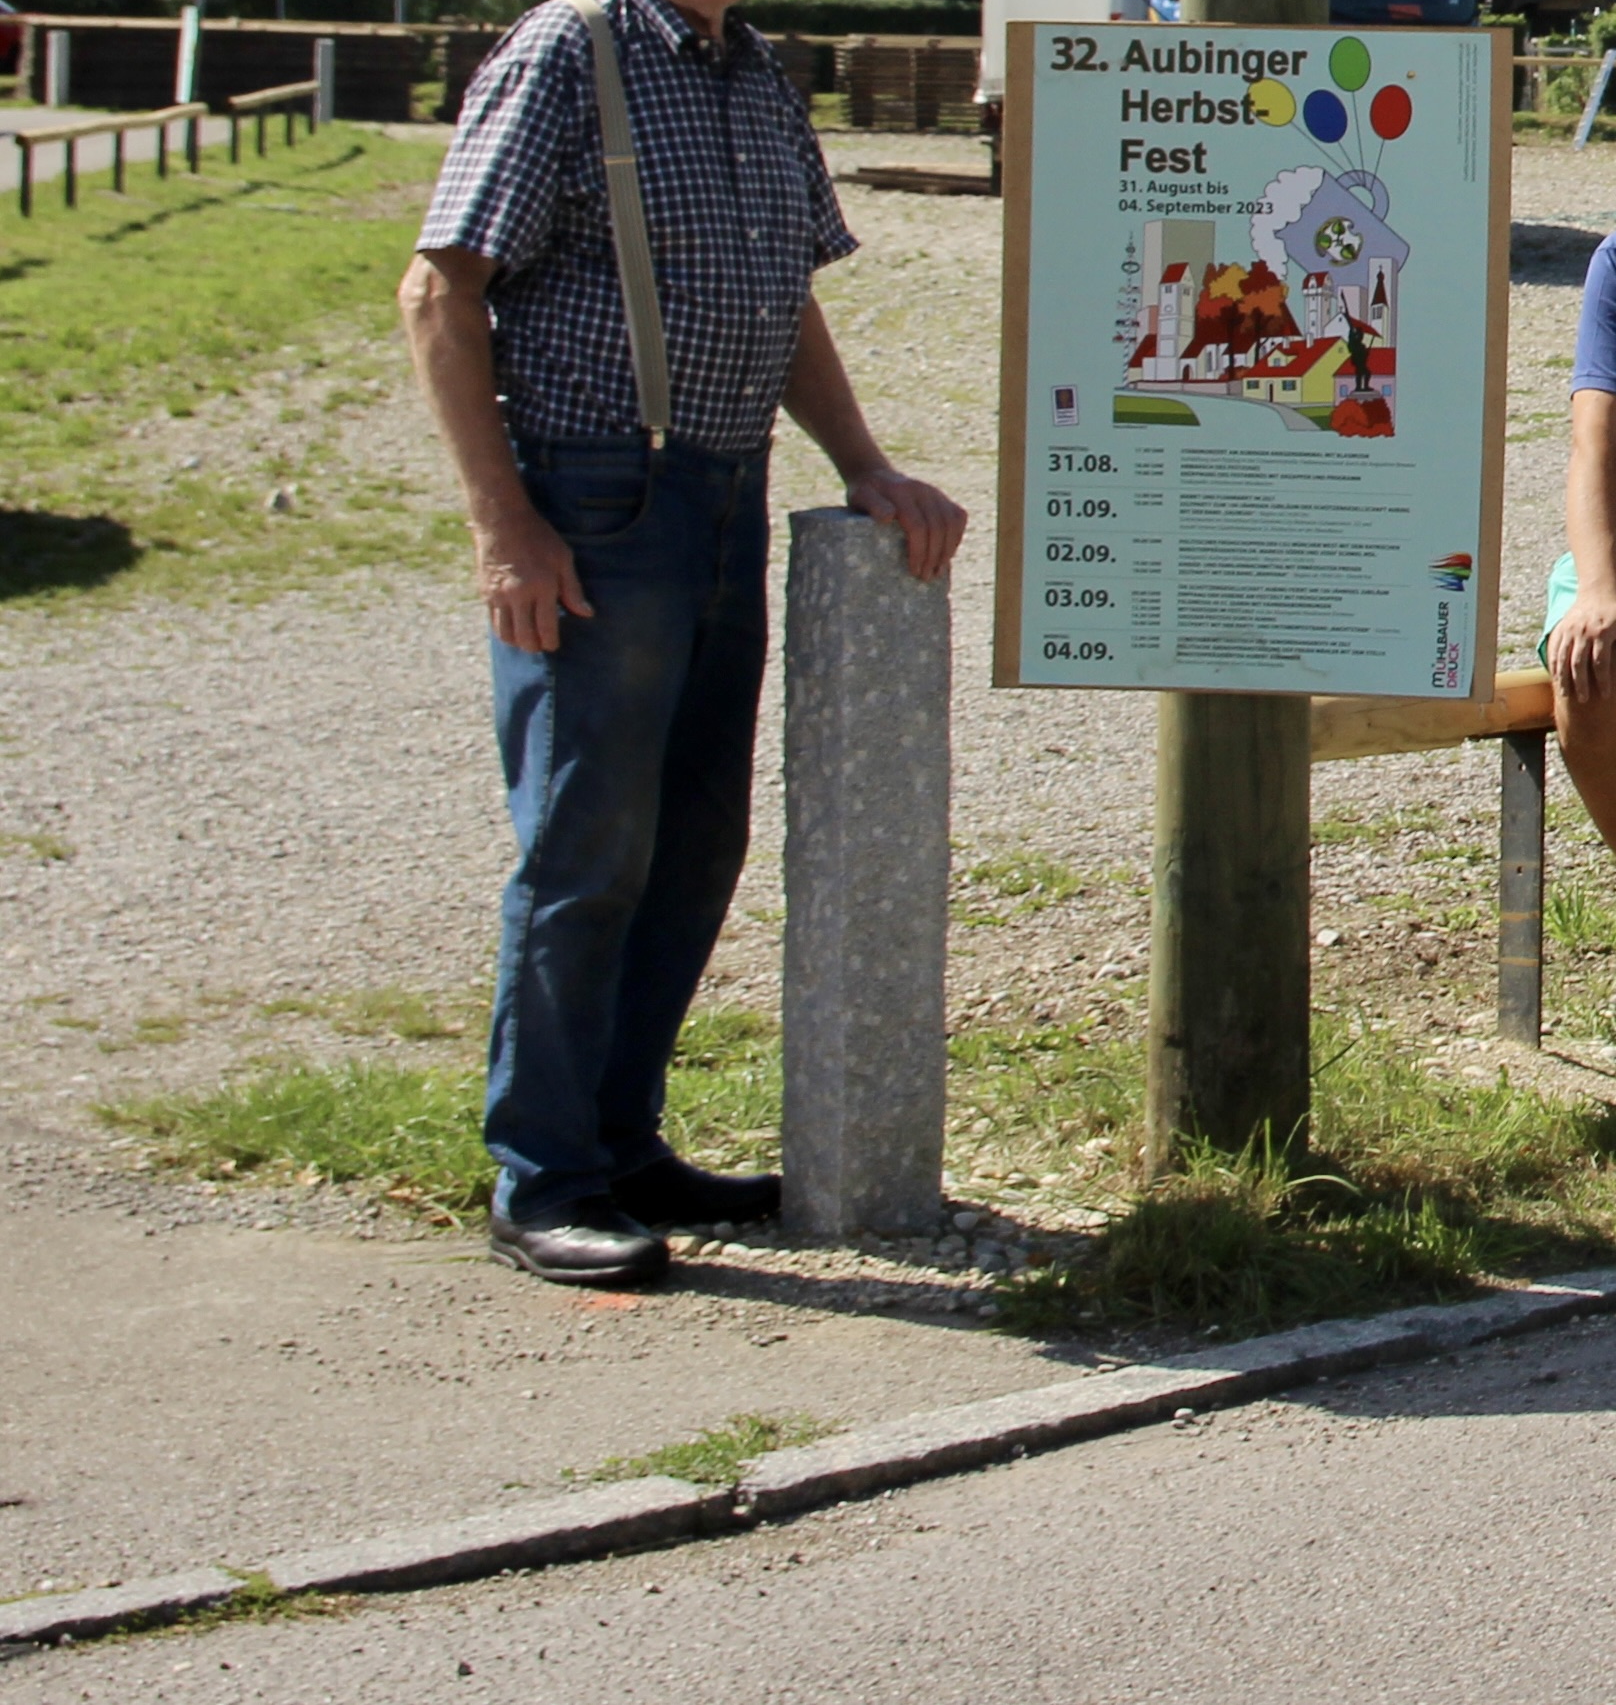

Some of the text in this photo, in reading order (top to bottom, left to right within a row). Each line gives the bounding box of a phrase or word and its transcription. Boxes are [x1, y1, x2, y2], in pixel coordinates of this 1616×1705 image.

[1050, 36, 1308, 83] 32. Aubinger
[1121, 88, 1270, 125] Herbst-
[1119, 138, 1208, 174] Fest
[1118, 180, 1229, 197] 31. August bis
[1118, 199, 1274, 216] 04. September 2023
[1048, 453, 1118, 473] 31.08.
[1046, 498, 1118, 518] 01.09.
[1046, 543, 1116, 563] 02.09.
[1045, 588, 1115, 608] 03.09.
[1043, 641, 1114, 661] 04.09.
[1446, 642, 1459, 689] DRUCK
